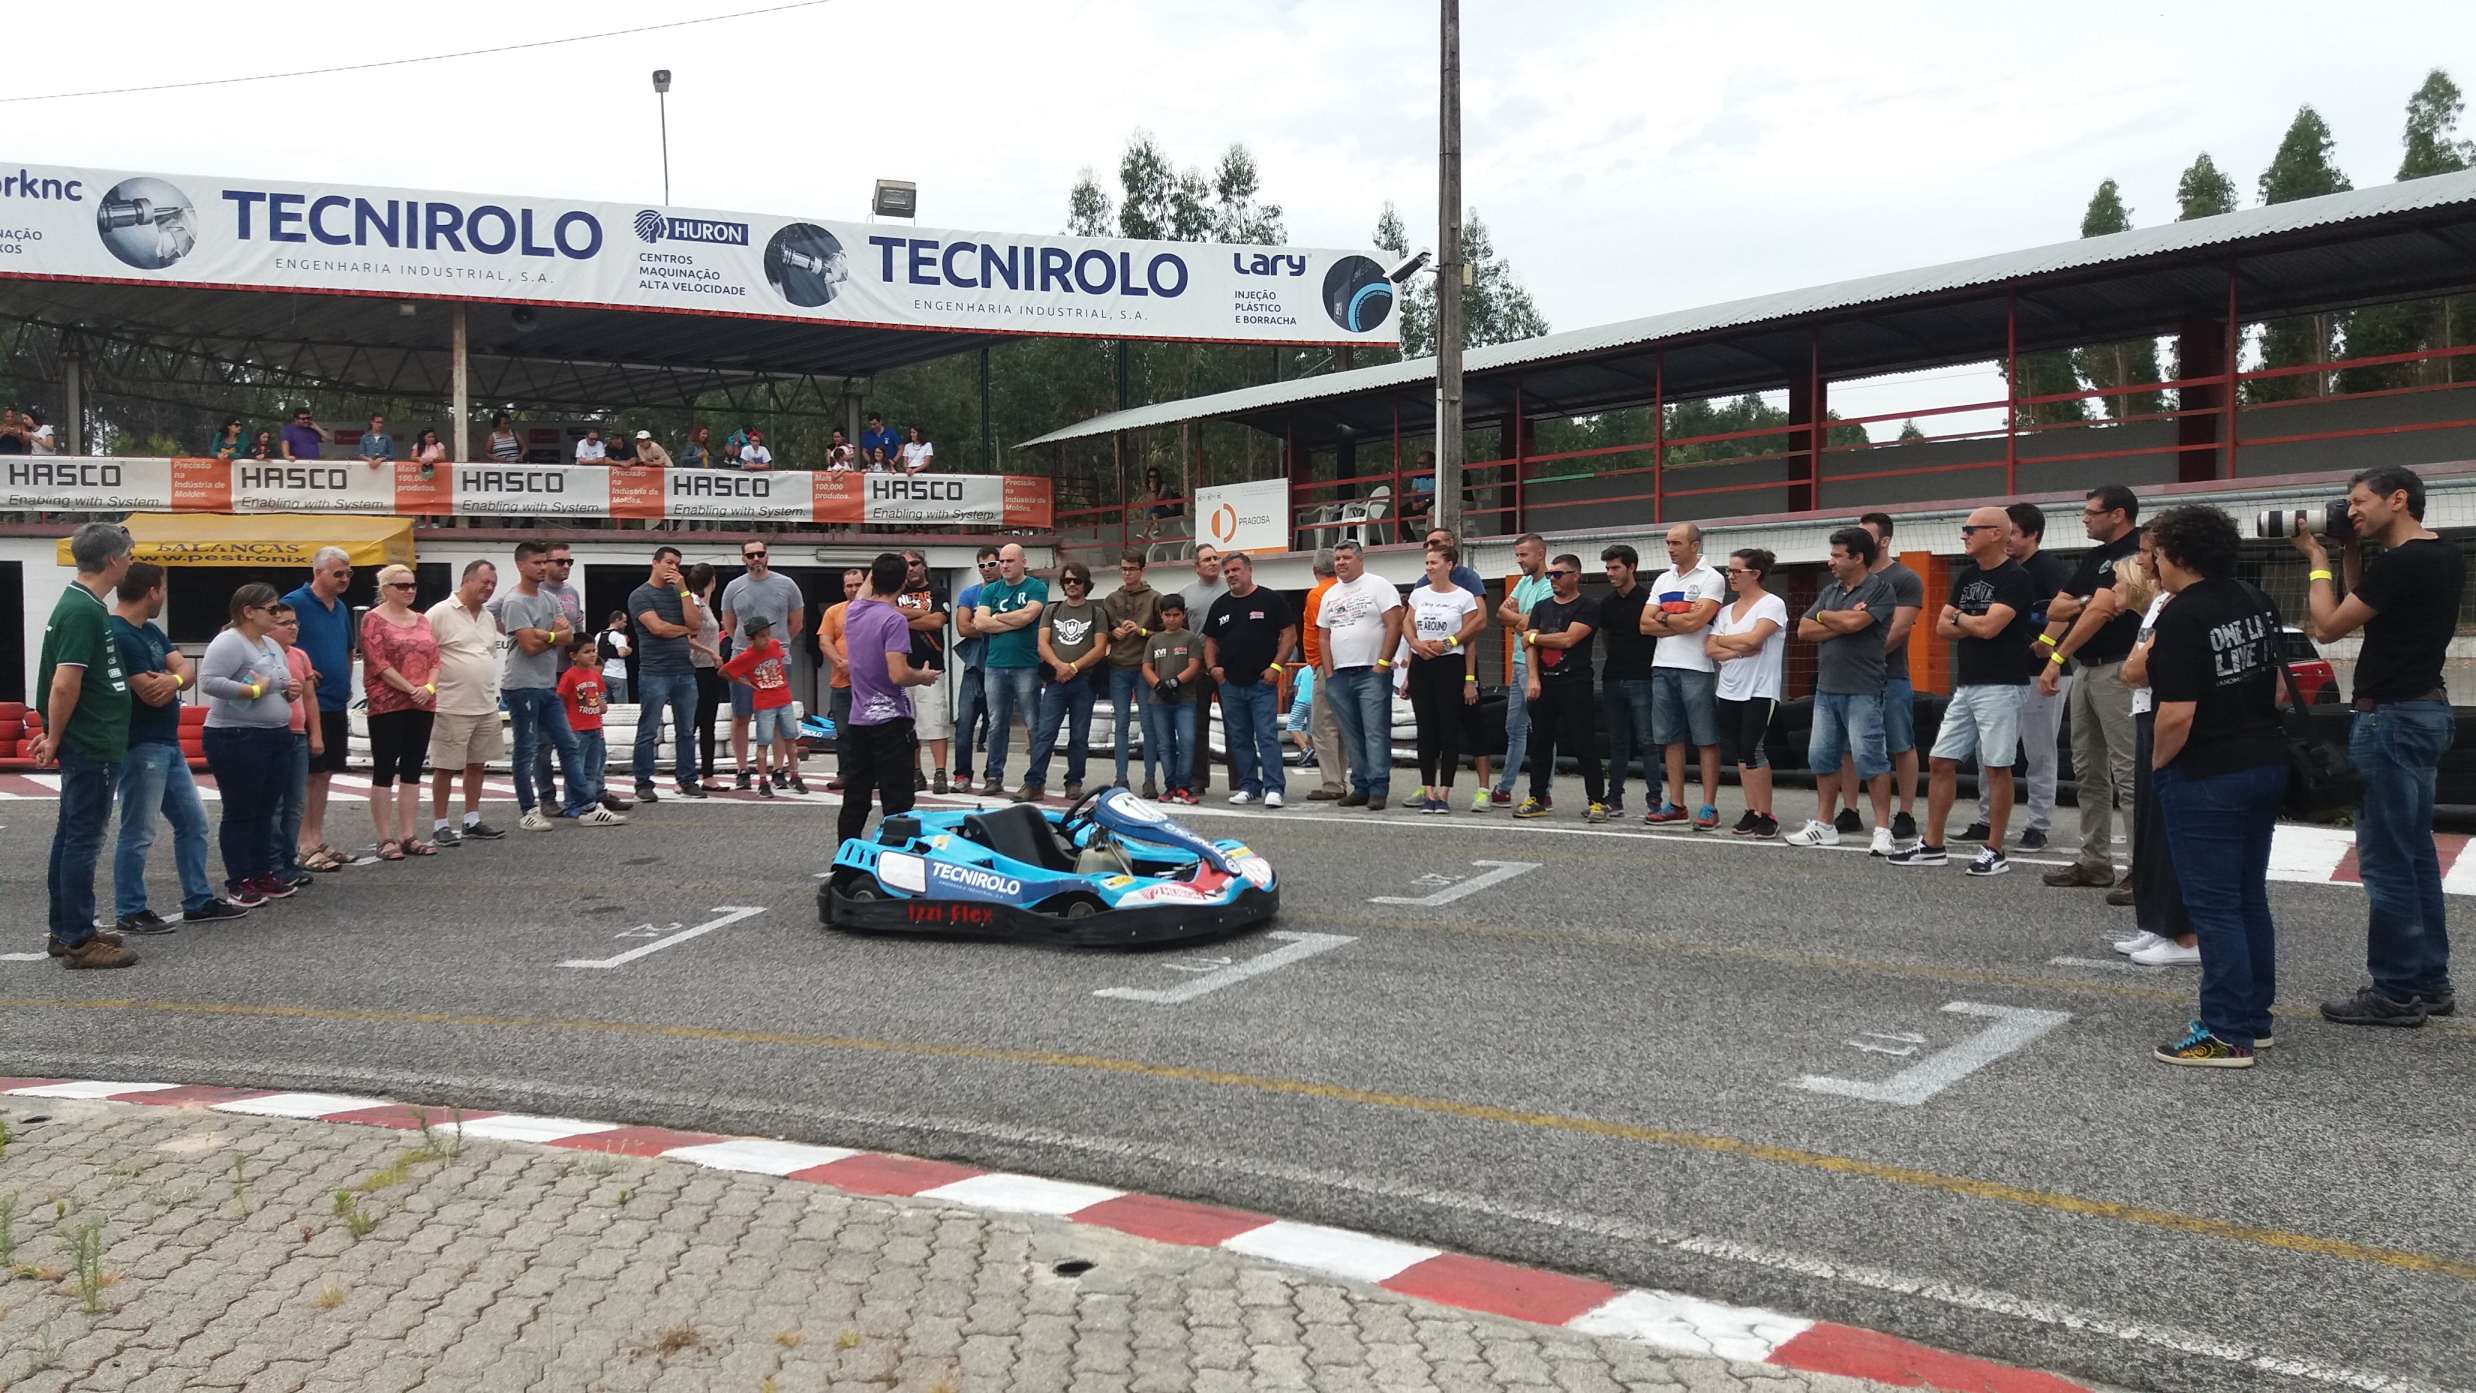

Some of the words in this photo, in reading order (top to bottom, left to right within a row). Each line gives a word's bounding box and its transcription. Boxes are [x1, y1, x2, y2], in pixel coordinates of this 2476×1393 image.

[0, 169, 82, 201] rknc
[222, 190, 603, 260] TECNIROLO
[674, 220, 742, 243] HURON
[639, 252, 694, 265] CENTROS
[868, 235, 1189, 298] TECNIROLO
[275, 258, 392, 275] ENGENHARIA
[400, 265, 512, 283] INDUSTRIAL,
[520, 271, 555, 284] S.A.
[639, 266, 721, 281] MAQUINAÇÃO
[638, 279, 670, 291] ALTA
[672, 281, 746, 296] VELOCIDADE
[1234, 289, 1277, 302] INJEÇÃO
[914, 299, 1013, 315] ENGENHARIA
[1019, 305, 1112, 321] INDUSTRIAL,
[1120, 310, 1148, 321] S.A.
[1234, 301, 1282, 313] PLÁSTICO
[1235, 315, 1241, 324] E
[1243, 315, 1297, 326] BORRACHA
[9, 464, 121, 487] HASCO
[241, 467, 348, 490] HASCO
[462, 471, 564, 493] HASCO
[673, 475, 770, 498] HASCO
[873, 480, 963, 501] HASCO
[8, 494, 71, 508] Enabling
[75, 495, 103, 507] with
[241, 496, 300, 510] Enabling
[304, 498, 331, 509] with
[462, 500, 519, 513] Enabling
[523, 501, 548, 513] with
[673, 503, 727, 518] Enabling
[730, 505, 755, 516] with
[873, 507, 923, 521] Enabling
[926, 509, 950, 520] with
[1238, 513, 1270, 527] PRAGOSA
[2209, 620, 2246, 652] ONE
[2214, 642, 2258, 677] LIVE
[931, 861, 1021, 896] TECNIROLO
